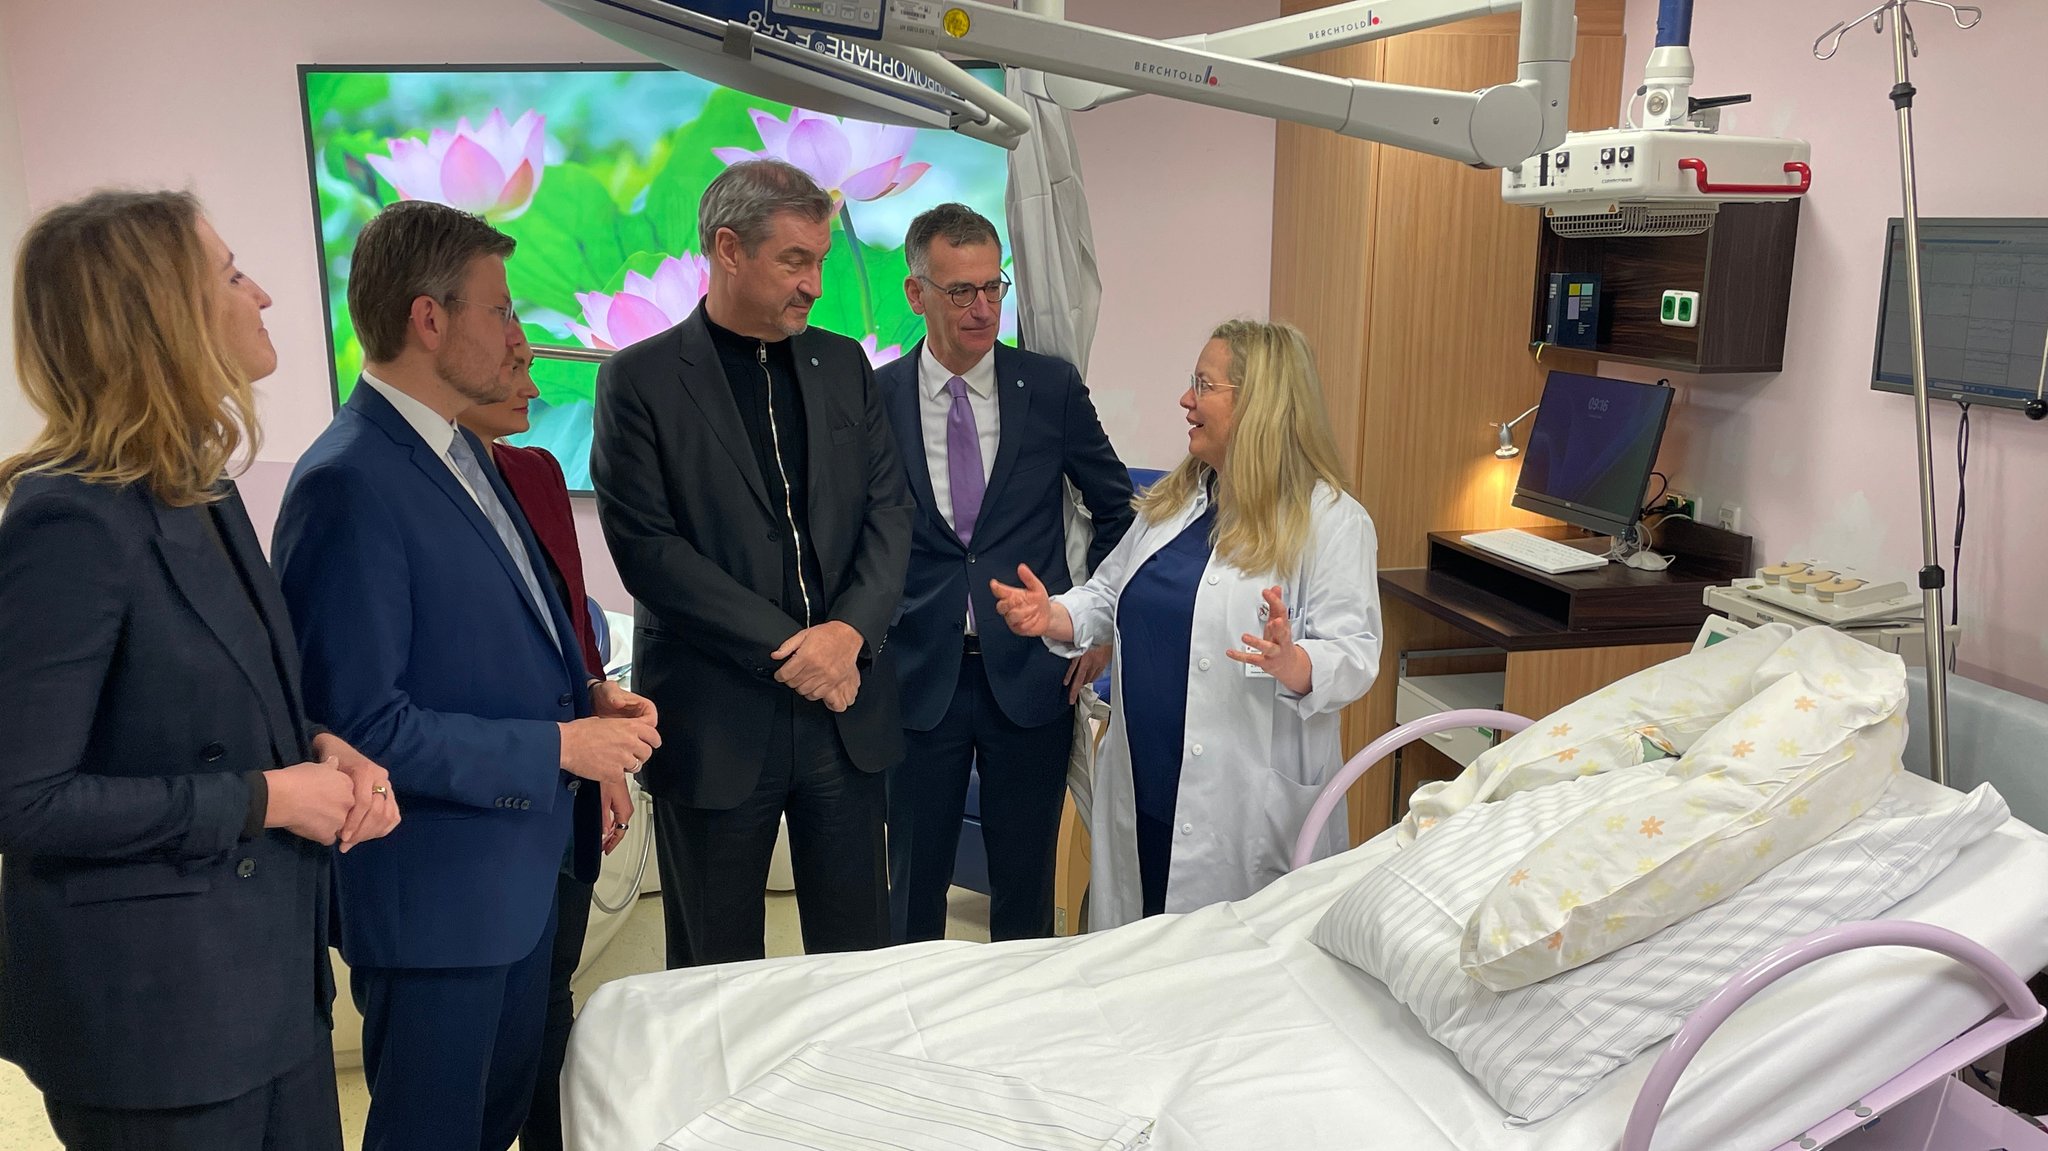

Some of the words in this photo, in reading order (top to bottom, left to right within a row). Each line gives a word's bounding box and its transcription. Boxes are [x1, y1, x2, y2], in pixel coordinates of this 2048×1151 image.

[747, 10, 788, 41] 558
[1308, 20, 1367, 40] BERCHTOLD
[795, 33, 812, 49] F
[1134, 61, 1202, 83] BERCHTOLD
